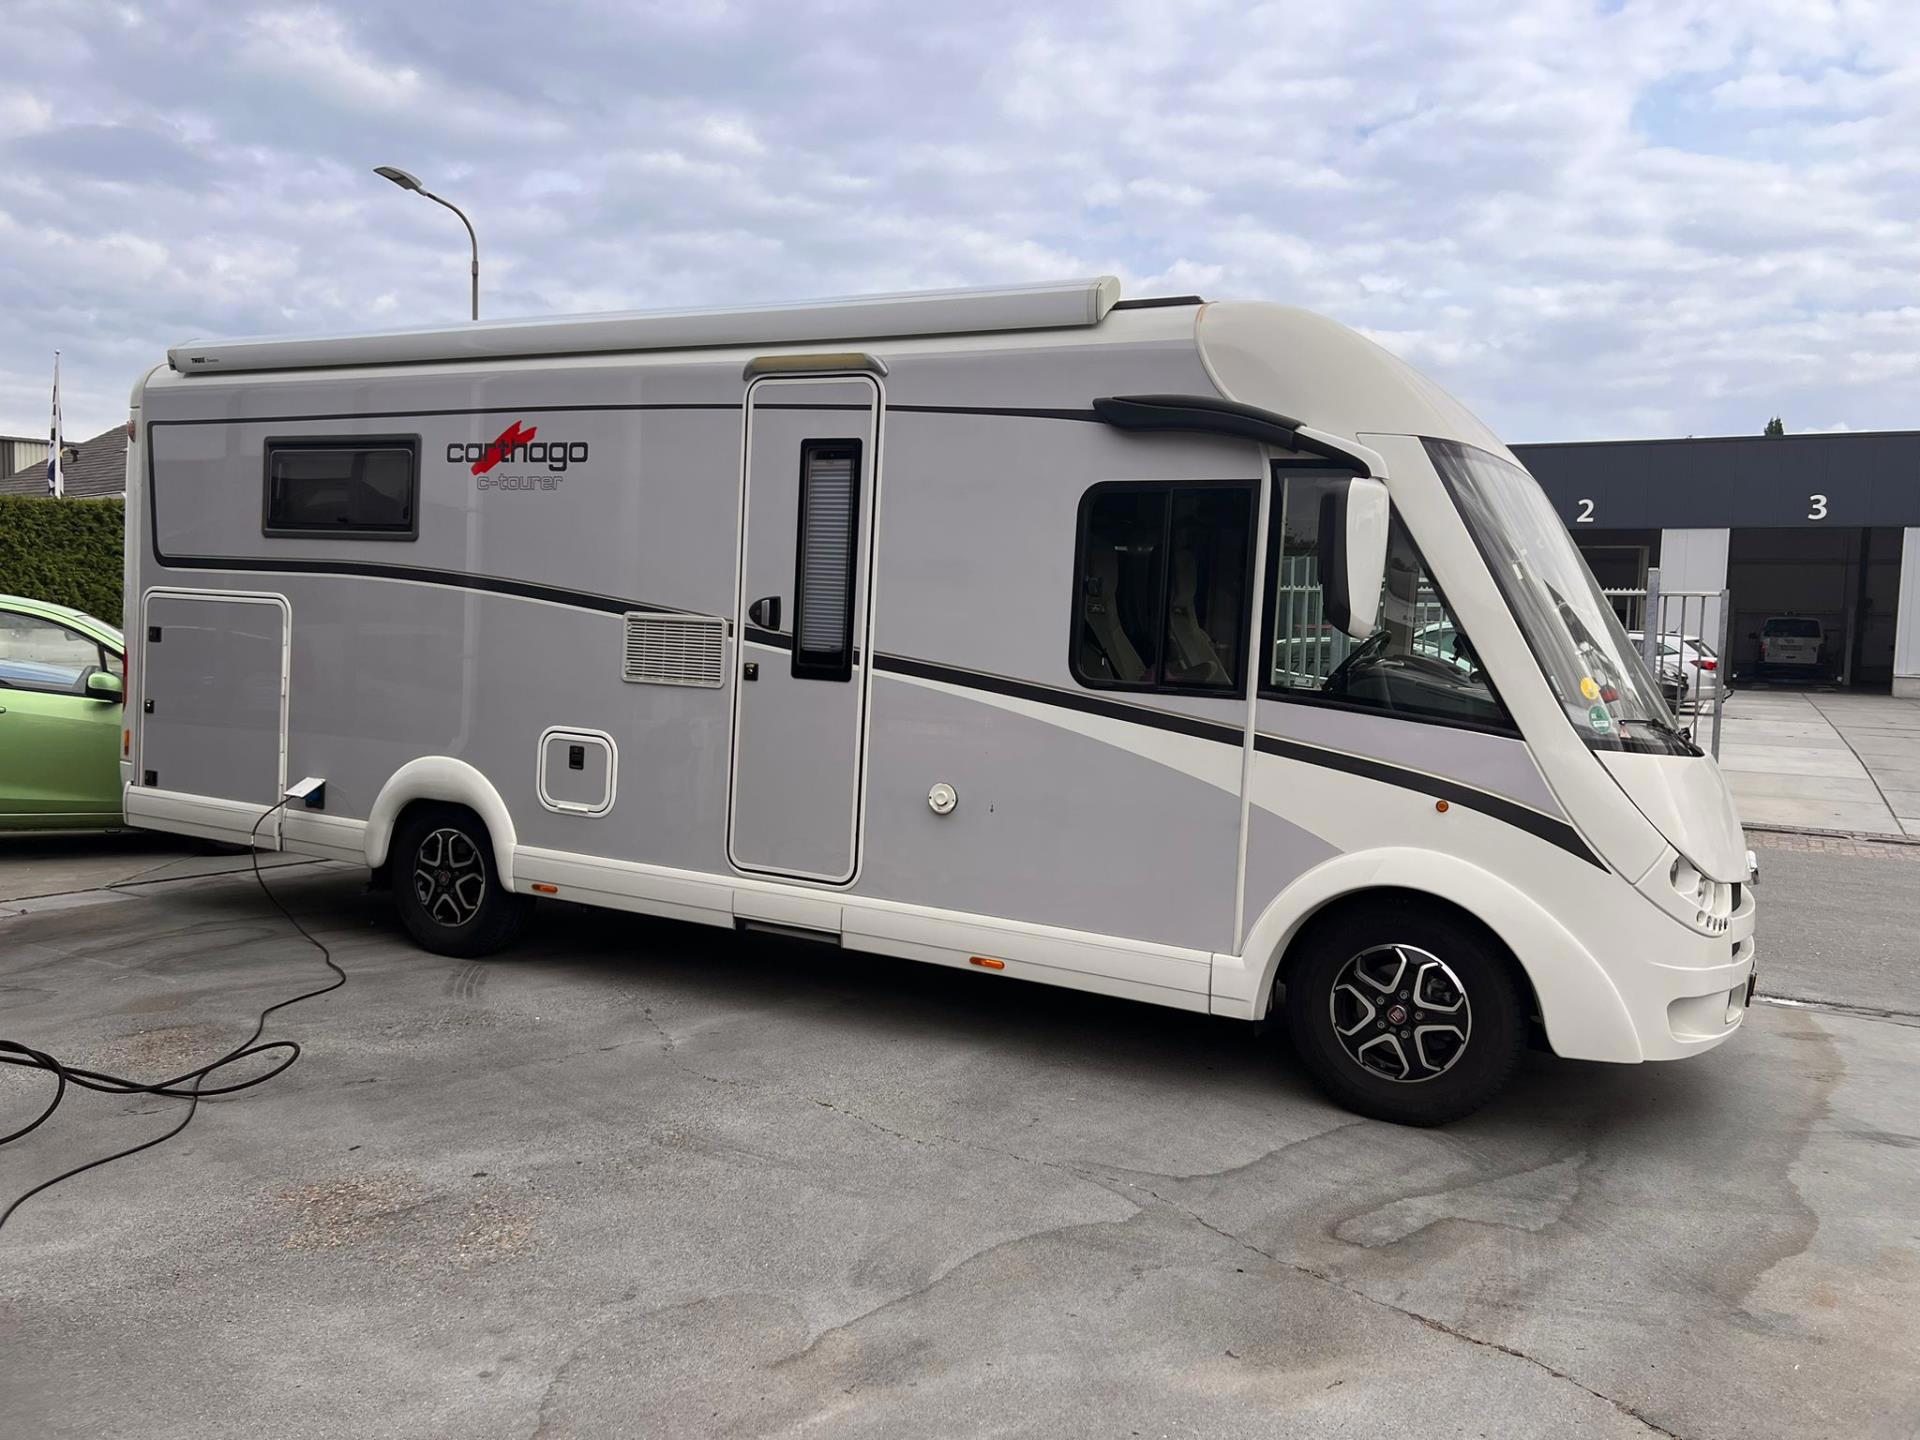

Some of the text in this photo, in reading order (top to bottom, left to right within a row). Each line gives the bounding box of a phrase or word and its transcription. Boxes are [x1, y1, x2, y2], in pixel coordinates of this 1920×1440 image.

[447, 440, 588, 472] carthago
[477, 474, 563, 491] c-tourer
[1576, 499, 1595, 523] 2
[1807, 494, 1828, 520] 3
